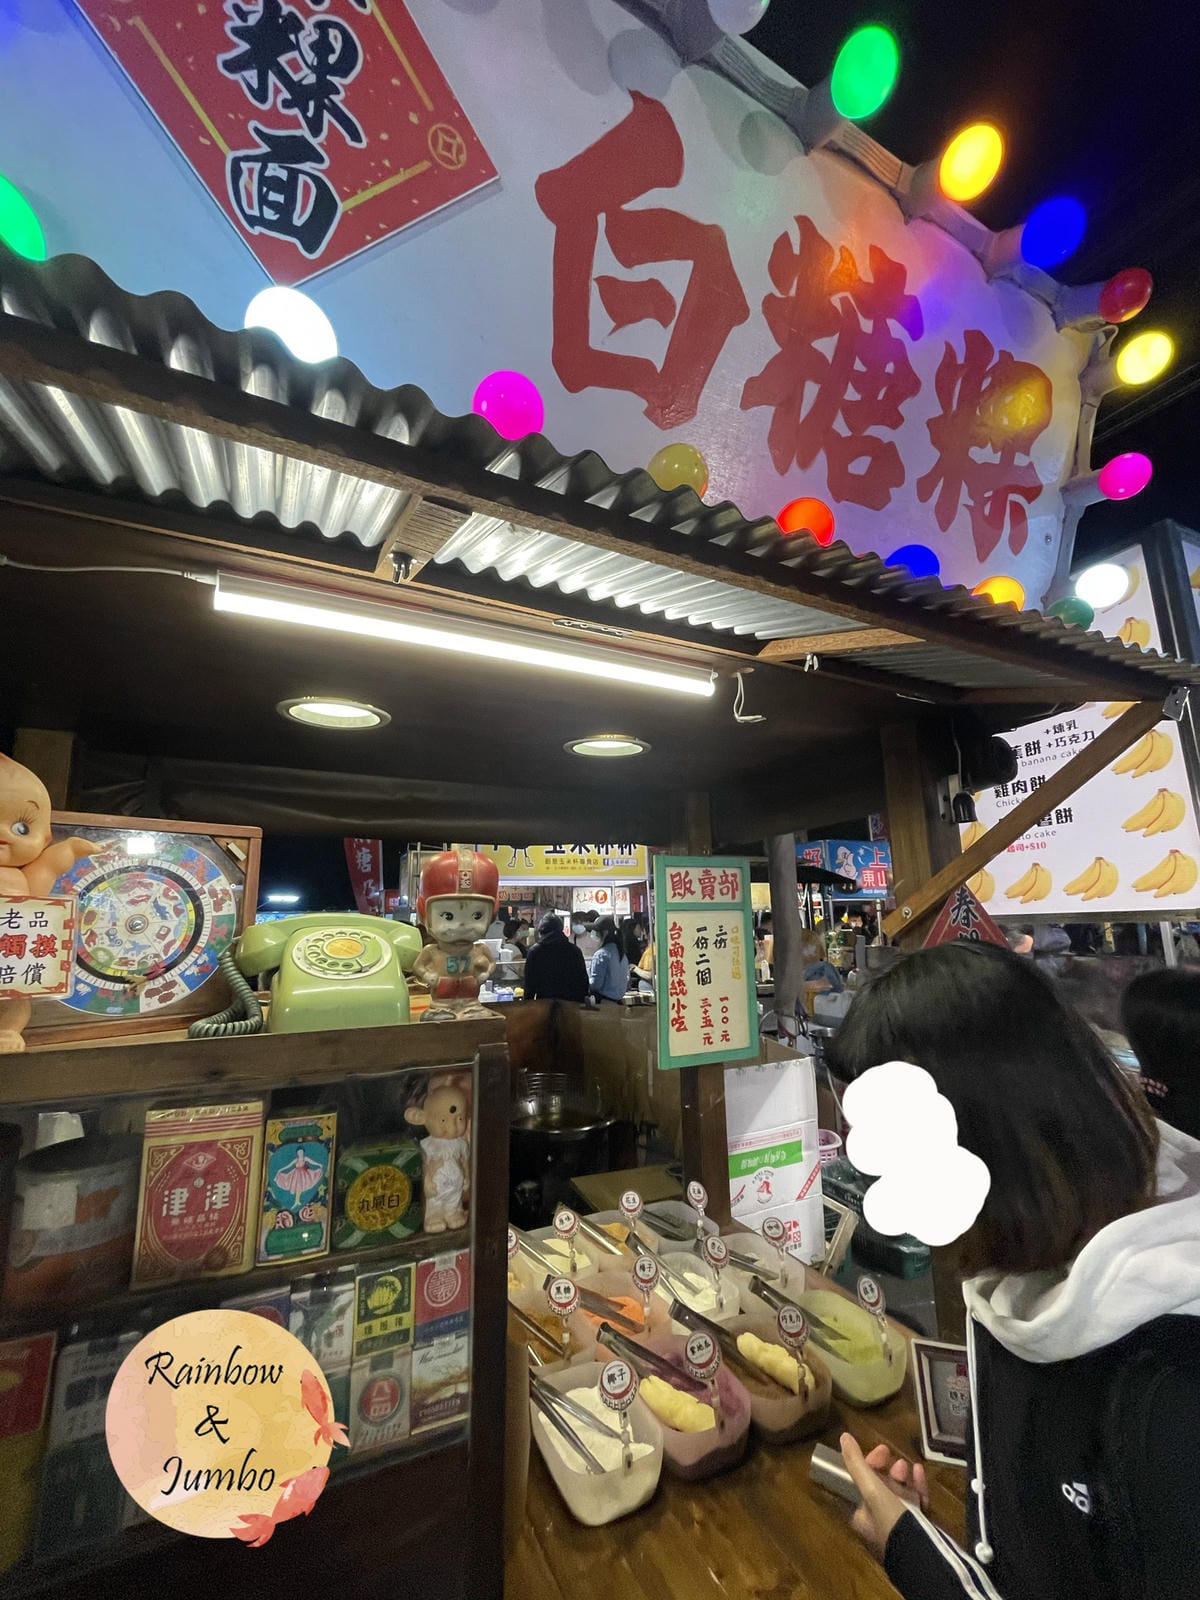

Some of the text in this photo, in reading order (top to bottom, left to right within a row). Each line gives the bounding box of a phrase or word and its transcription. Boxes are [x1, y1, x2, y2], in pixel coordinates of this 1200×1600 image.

[535, 88, 1053, 563] 白糖粿
[1021, 752, 1057, 767] banana
[670, 868, 739, 900] 販賣部
[862, 870, 888, 887] 東山
[447, 956, 471, 974] 57
[693, 925, 713, 986] 一份二個
[669, 921, 688, 1033] 台南傳統小吃
[161, 1181, 232, 1217] 津津
[781, 1314, 801, 1324] 巧克力
